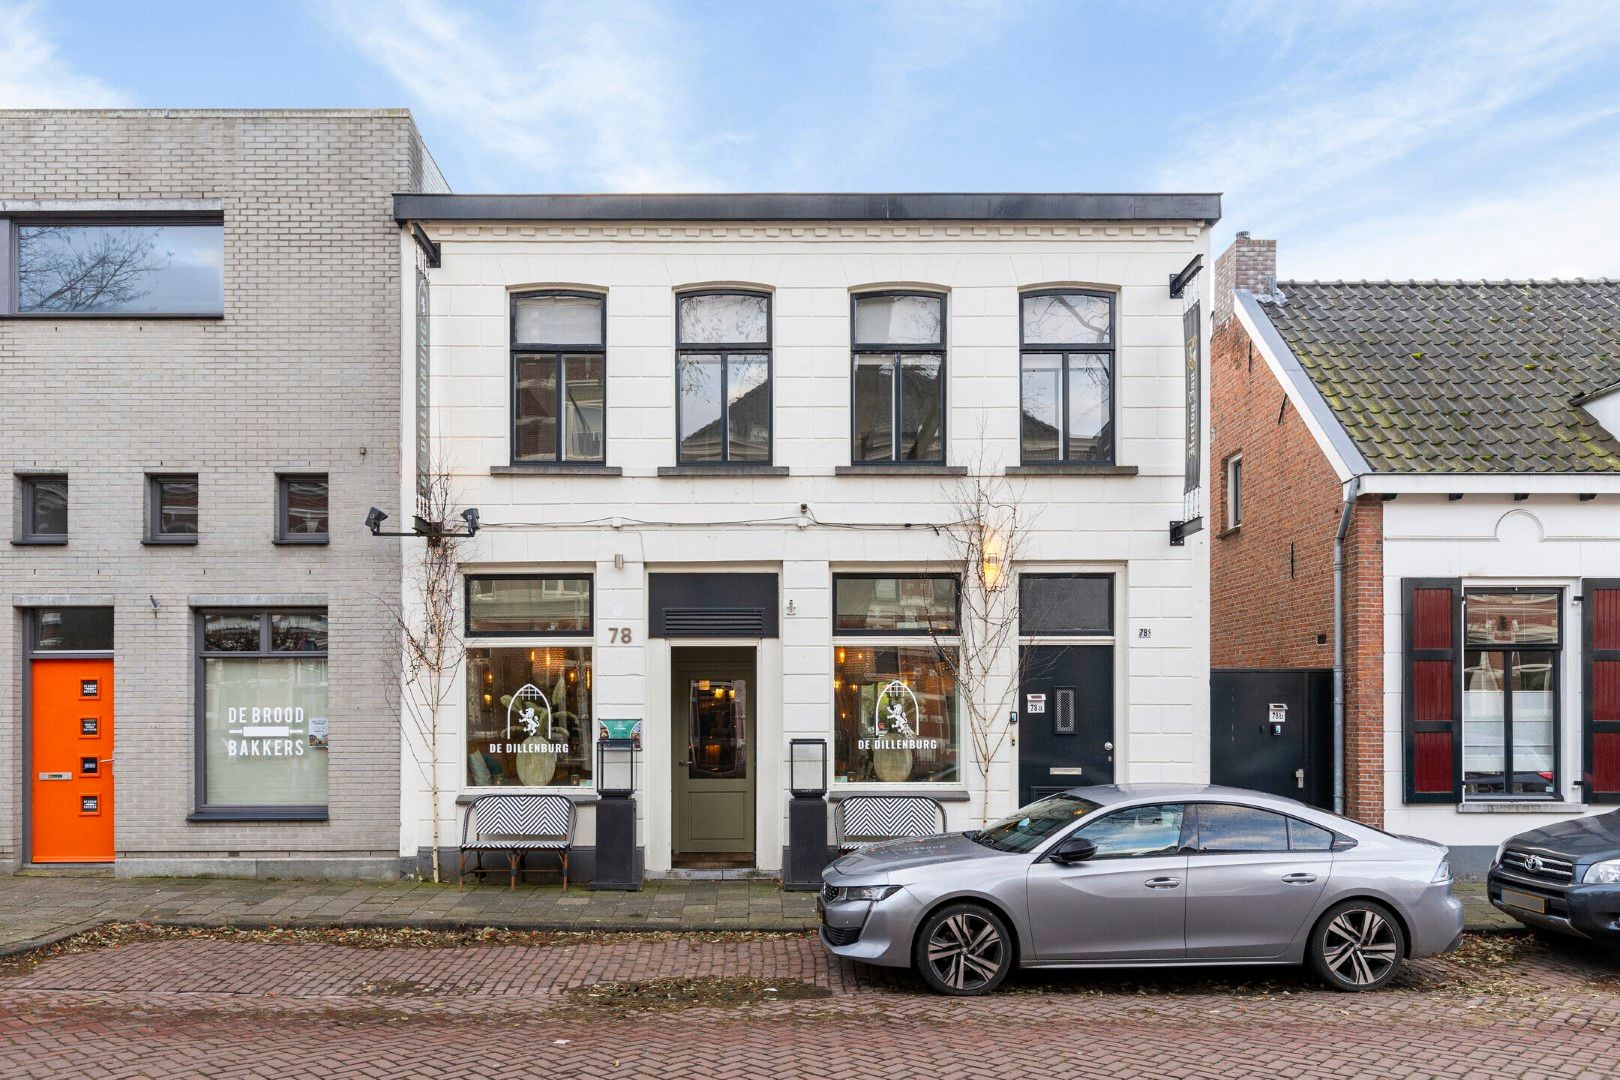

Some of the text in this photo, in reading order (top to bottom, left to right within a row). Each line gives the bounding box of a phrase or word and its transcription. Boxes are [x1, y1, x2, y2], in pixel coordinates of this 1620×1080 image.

[419, 321, 429, 453] DILLENBURG
[608, 627, 632, 644] 78
[228, 707, 304, 723] DE BROOD
[228, 739, 304, 756] BAKKERS
[489, 743, 569, 754] DE DILLENBURG
[858, 740, 937, 750] DE DILLENBURG
